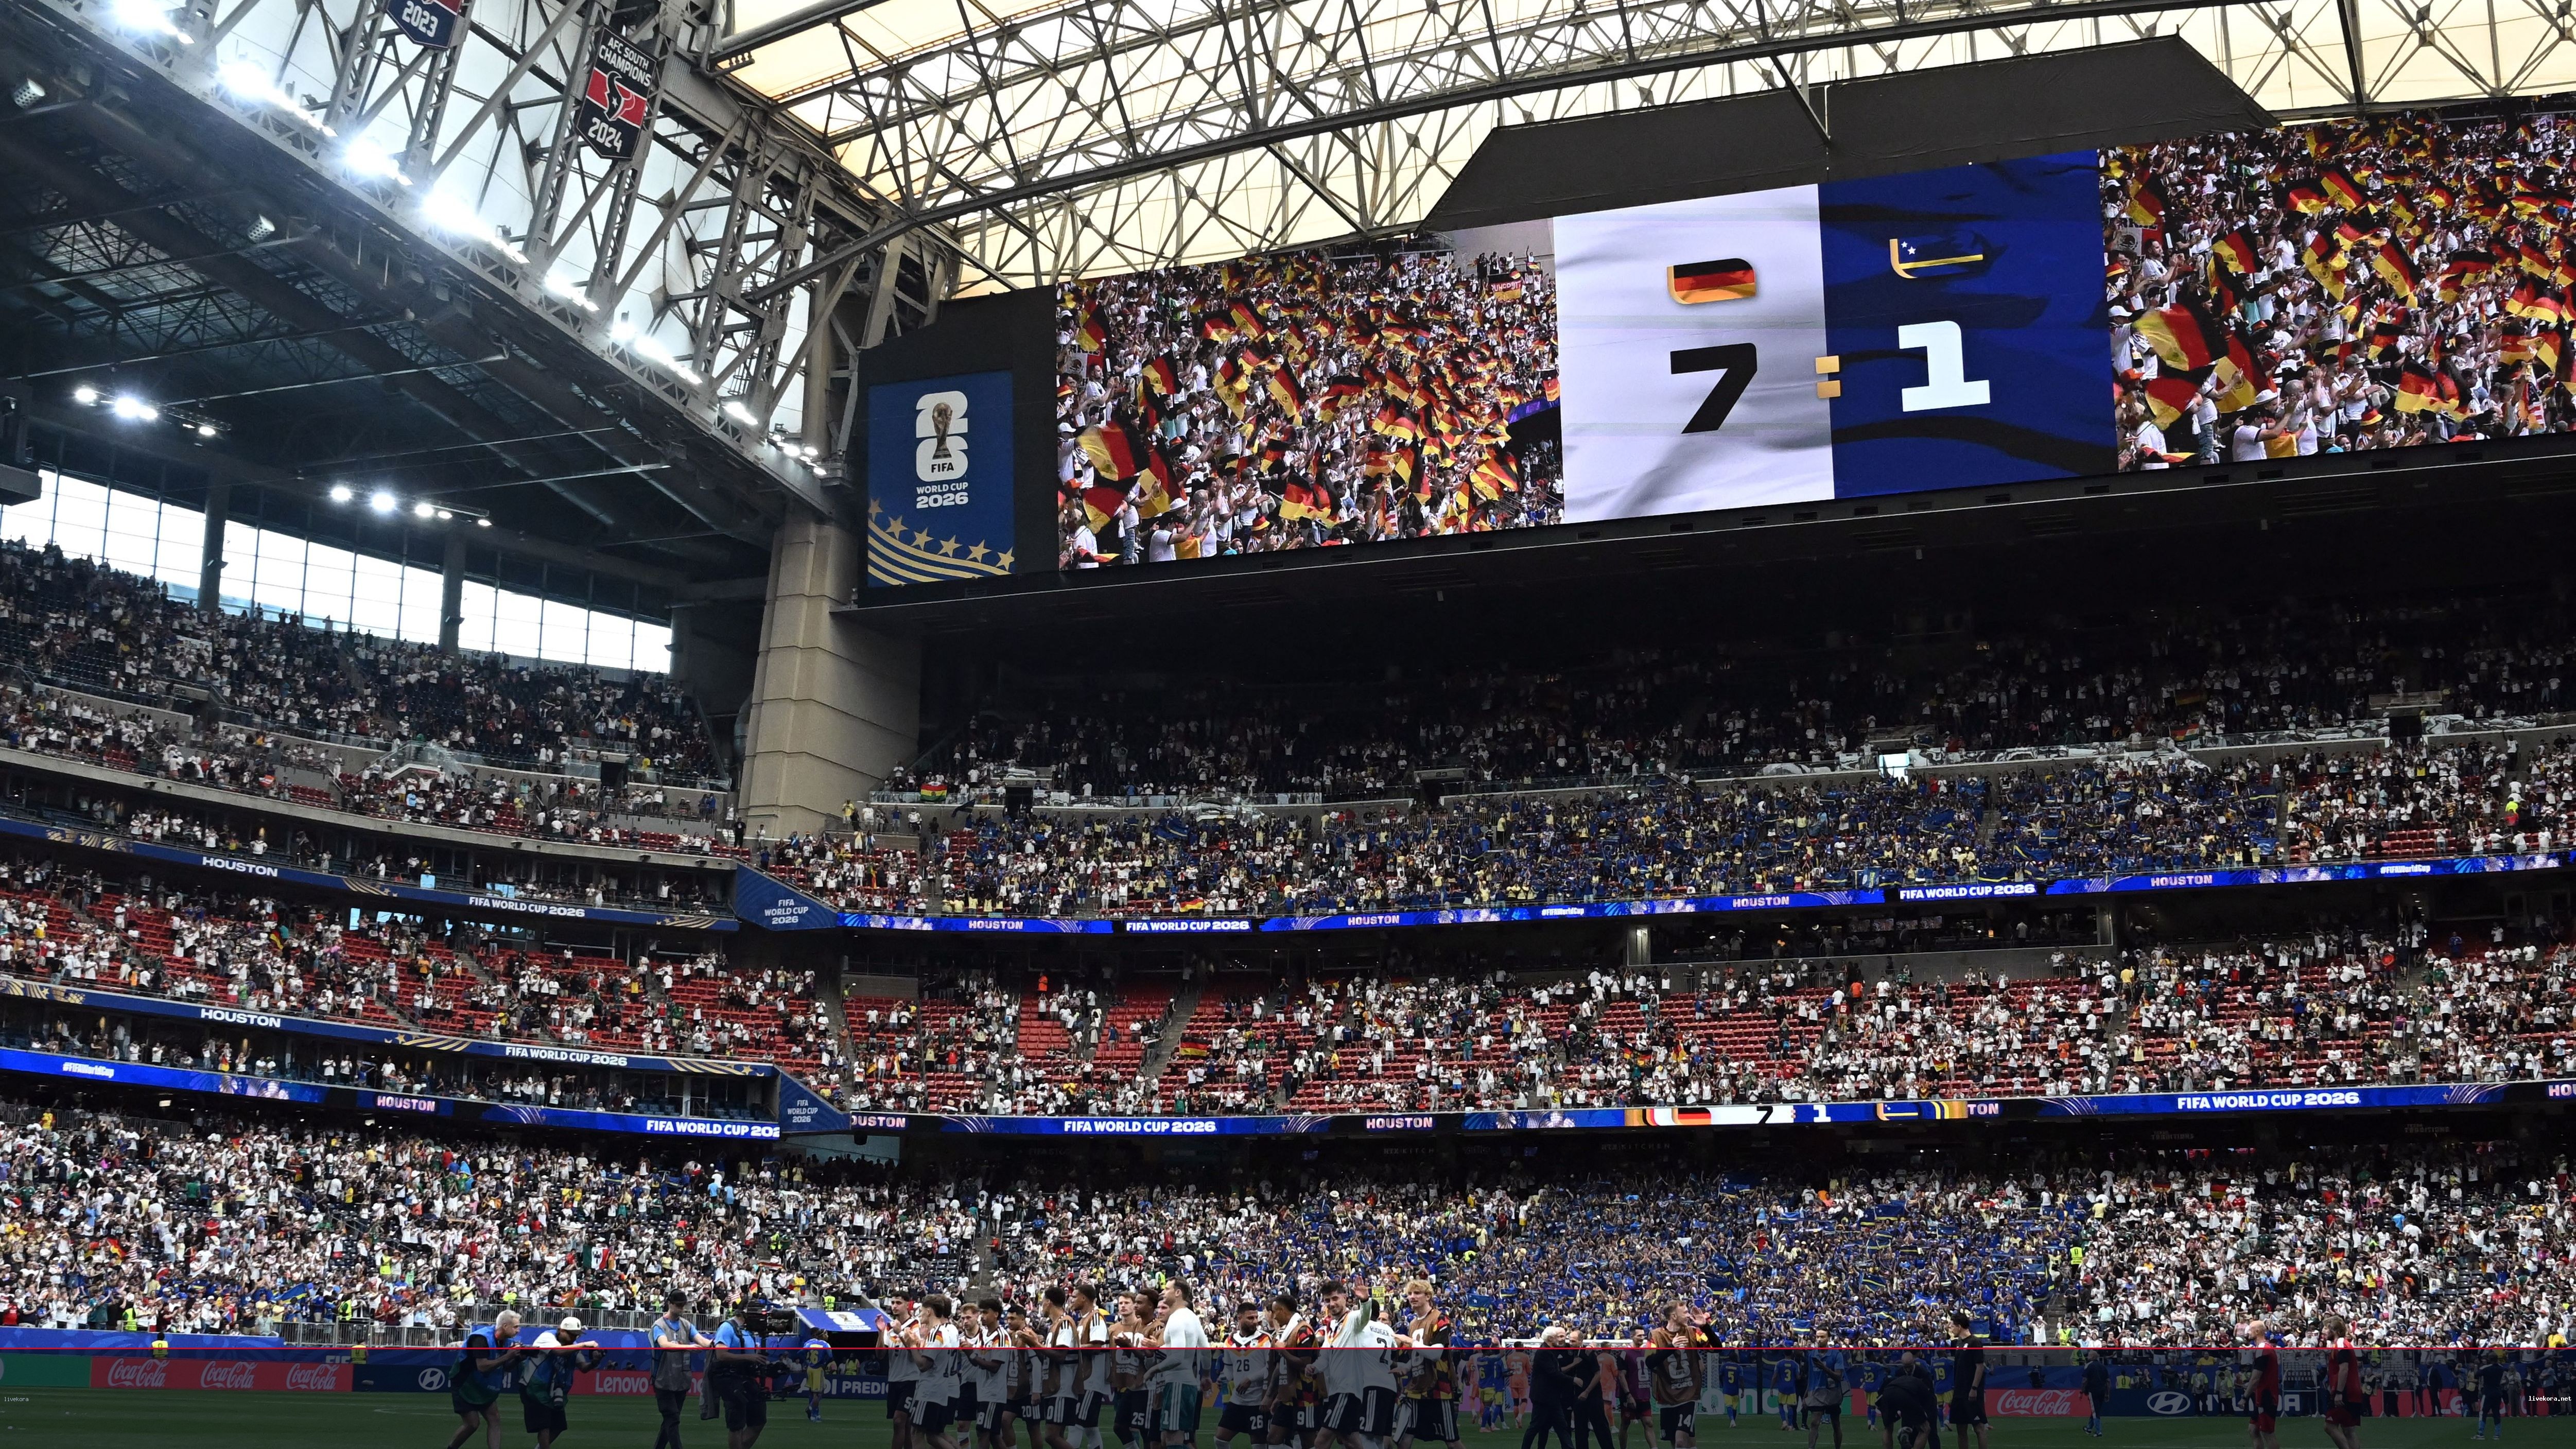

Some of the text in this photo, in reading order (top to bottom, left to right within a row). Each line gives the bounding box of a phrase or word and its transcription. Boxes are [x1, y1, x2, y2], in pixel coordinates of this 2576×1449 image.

[402, 1, 438, 38] 2023
[607, 37, 649, 70] AFC SOUTH
[599, 45, 652, 86] CHAMPIONS
[588, 117, 622, 152] 2024
[1670, 343, 1757, 434] 7
[1898, 320, 1990, 411] 1
[931, 462, 954, 473] FIFA
[916, 482, 968, 494] WORLD CUP
[916, 492, 968, 509] 2026
[202, 857, 277, 877] HOUSTON
[2151, 875, 2212, 886] HOUSTON
[1900, 884, 2034, 899] FIFA WORLD CUP 2026
[469, 897, 585, 917] FIFA WORLD CUP 2026
[1733, 896, 1789, 907] HOUSTON
[772, 916, 798, 924] 2026
[969, 920, 1023, 929] HOUSTON
[1126, 921, 1249, 931] FIFA WORLD CUP 2026
[1348, 915, 1399, 925] HOUSTON
[201, 1009, 281, 1027] HOUSTON
[506, 1046, 628, 1066] FIFA WORLD CUP 2026
[377, 1096, 435, 1111] HOUSTON
[2178, 1092, 2359, 1109] FIFA WORLD CUP 2026
[851, 1115, 906, 1127] OUSTON
[1756, 1106, 1773, 1124] 7
[1813, 1105, 1831, 1123] 1
[647, 1120, 779, 1137] FIFA WORLD CUP 202
[1065, 1121, 1215, 1132] FIFA WORLD CUP 2026
[1367, 1117, 1432, 1128] HOUSTON
[1377, 1337, 1388, 1365] 2
[108, 1358, 169, 1387] Coca-Cola
[1237, 1359, 1250, 1372] 26
[200, 1360, 257, 1389] Coca-Cola
[286, 1363, 339, 1390] Coca-Cola
[1728, 1371, 1734, 1384] 5
[1784, 1369, 1791, 1382] 3
[1935, 1367, 1946, 1381] 19
[595, 1372, 649, 1393] Lenovo
[842, 1381, 889, 1395] PREDI
[1996, 1389, 2075, 1415] Coca-Cola
[1021, 1406, 1032, 1418] 20
[1131, 1412, 1145, 1425] 25
[1297, 1411, 1305, 1425] 9
[1250, 1415, 1263, 1430] 26
[1678, 1414, 1692, 1427] 14
